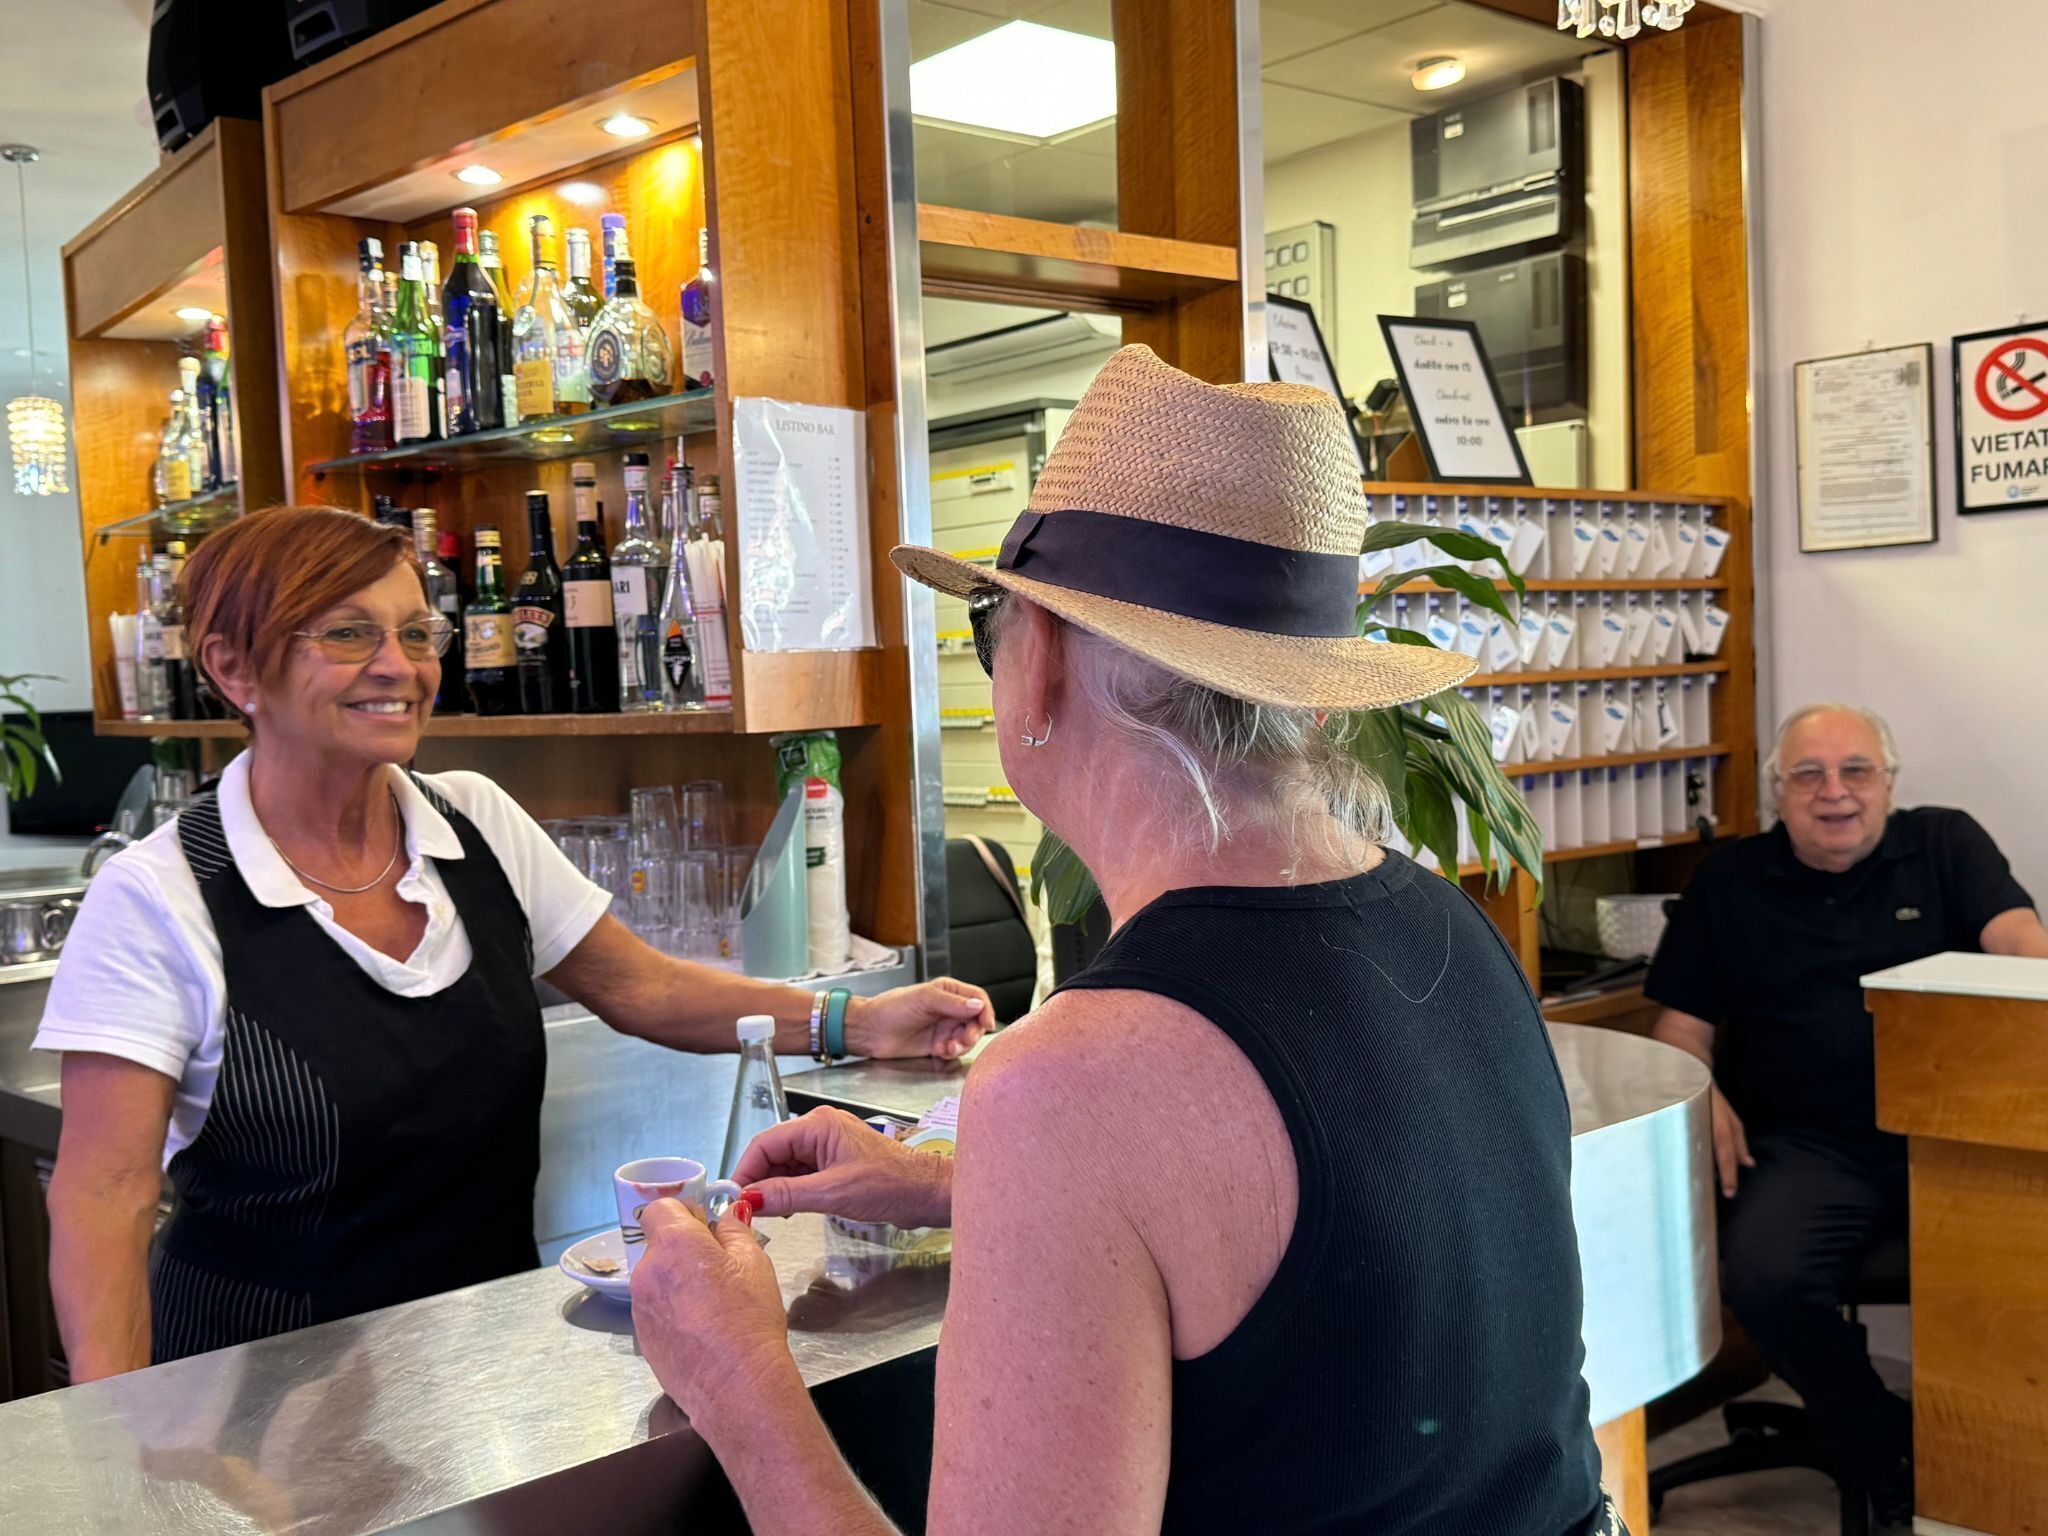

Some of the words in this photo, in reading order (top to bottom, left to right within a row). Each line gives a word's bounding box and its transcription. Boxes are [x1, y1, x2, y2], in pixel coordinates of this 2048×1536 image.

[776, 419, 815, 434] LISTINO
[817, 422, 835, 436] BAR
[1971, 428, 2048, 454] VIETAT
